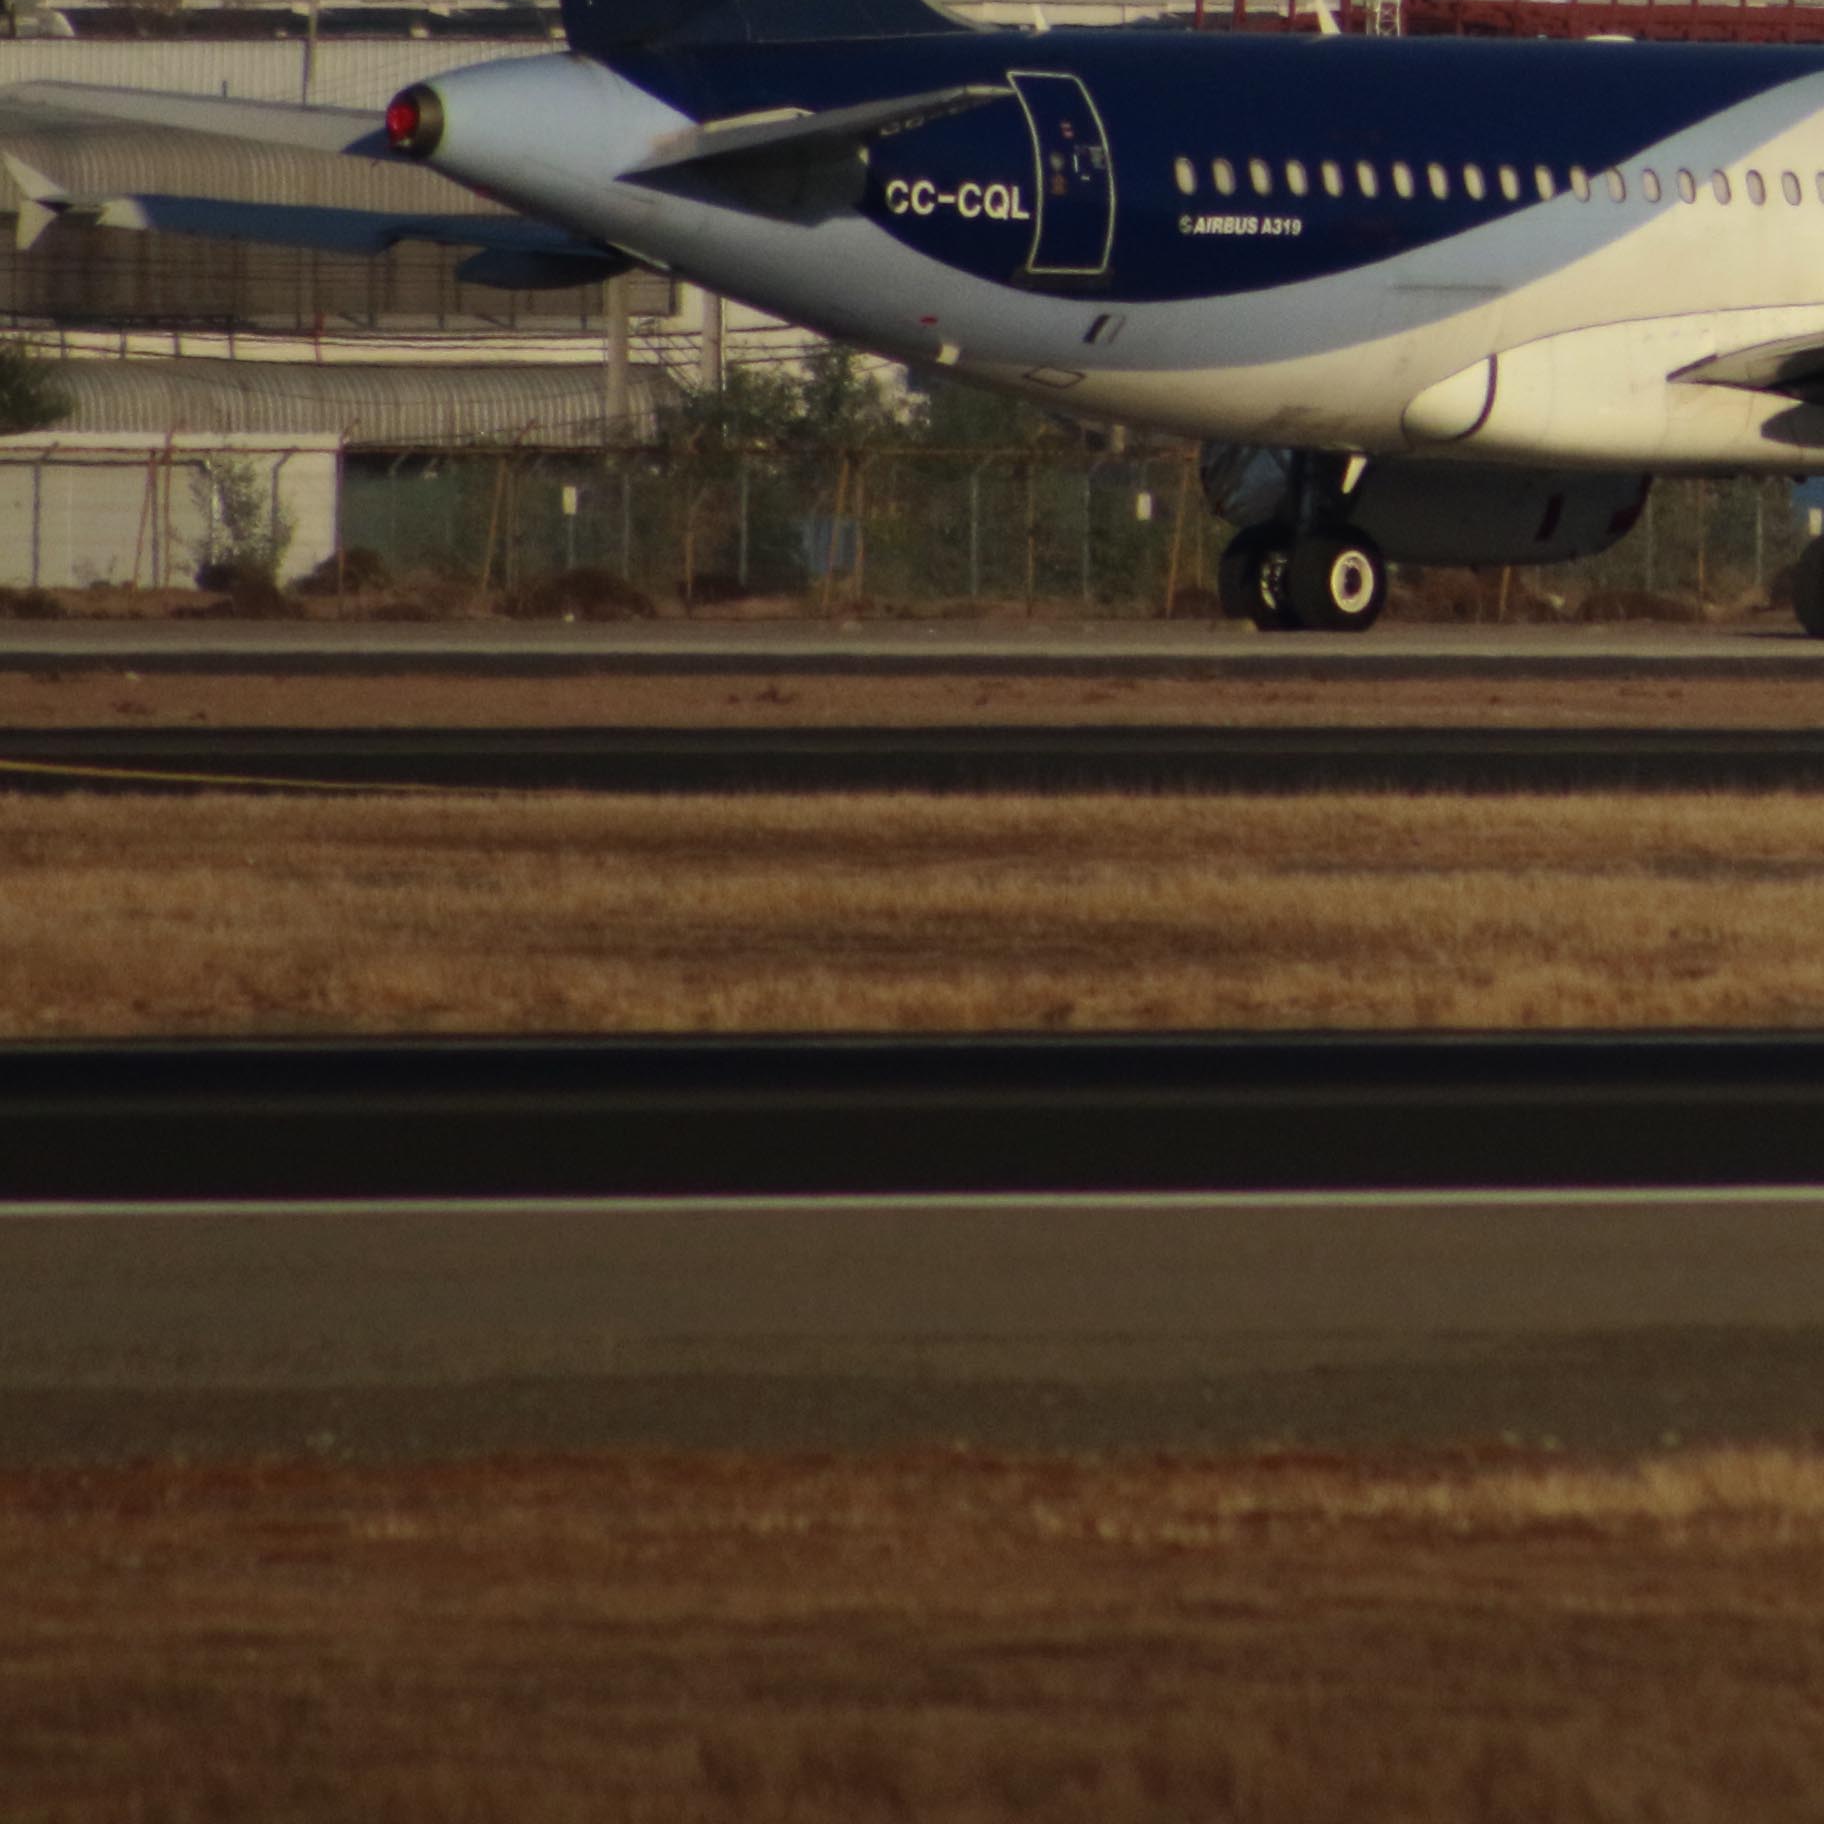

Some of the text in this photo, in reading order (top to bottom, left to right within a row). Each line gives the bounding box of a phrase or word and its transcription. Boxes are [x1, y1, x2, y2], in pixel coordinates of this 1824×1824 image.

[886, 179, 1030, 220] CC-CQL
[1193, 216, 1302, 236] AIRBUS A319
